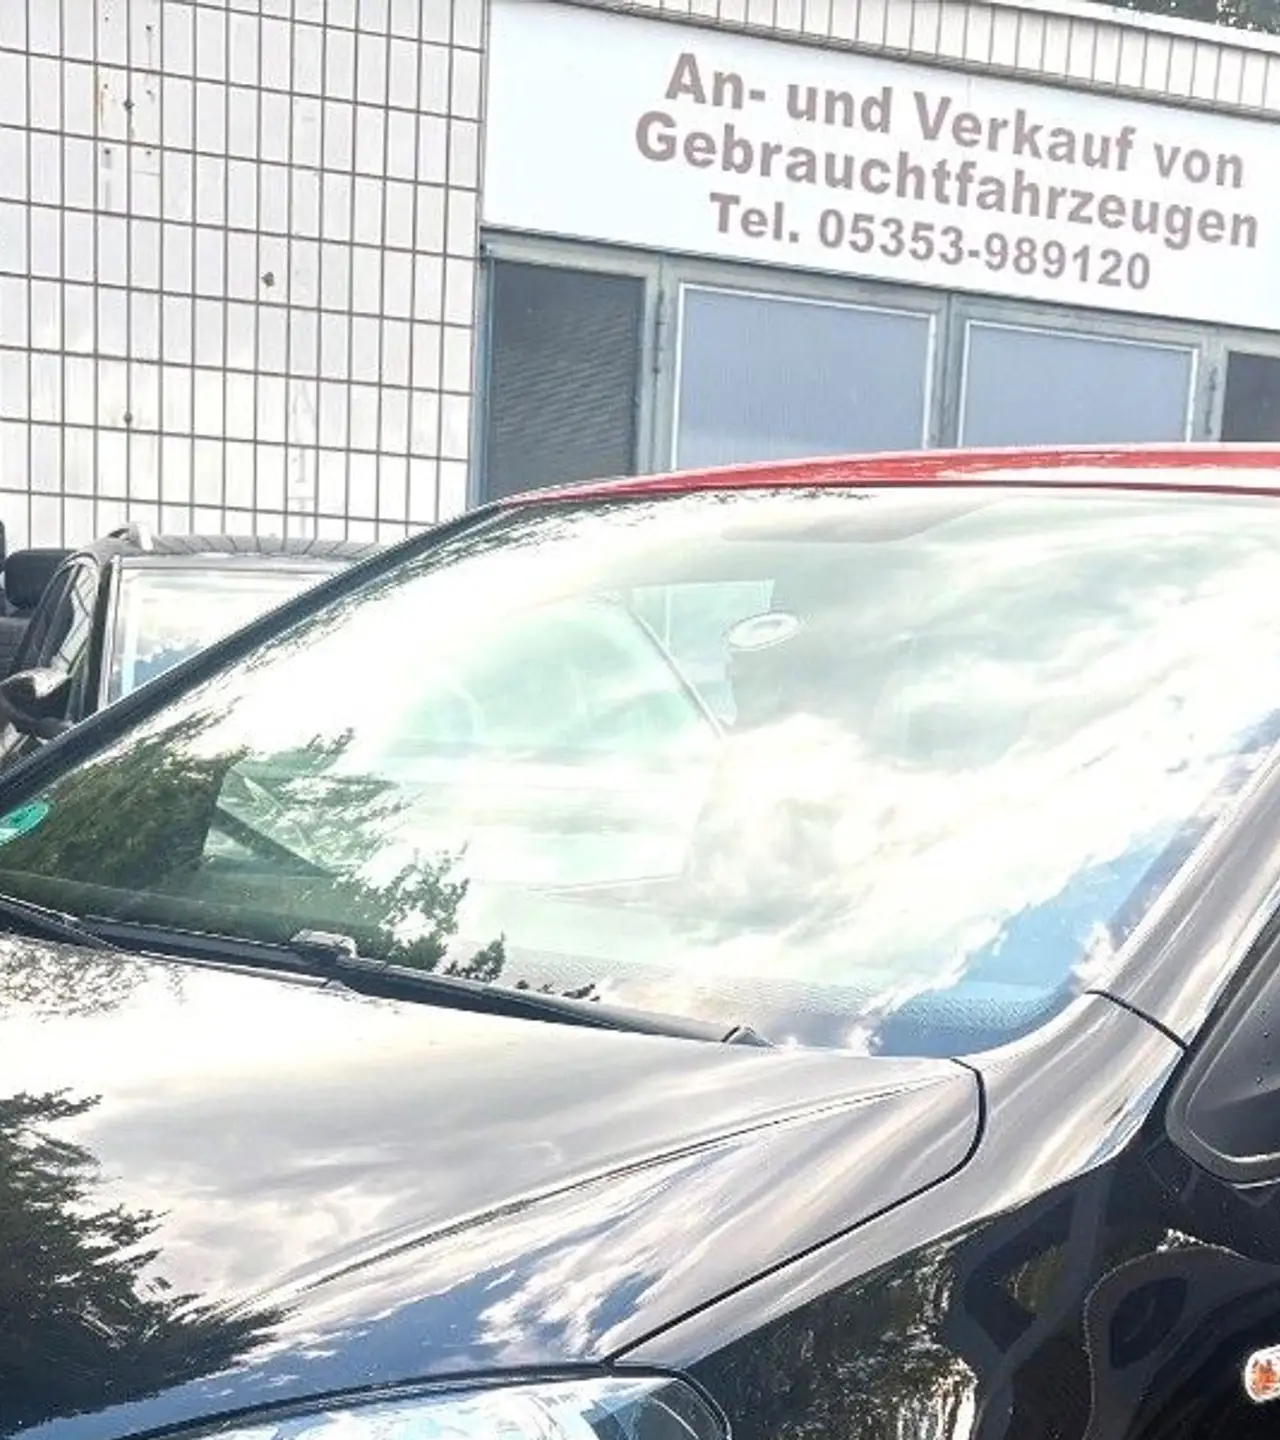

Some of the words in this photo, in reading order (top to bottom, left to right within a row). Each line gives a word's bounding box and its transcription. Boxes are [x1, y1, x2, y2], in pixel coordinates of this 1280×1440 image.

[635, 110, 1258, 251] Gebrauchtfahrzeugen
[664, 52, 766, 110] An-
[786, 83, 893, 134] und
[913, 90, 1136, 173] Verkauf
[1153, 143, 1243, 189] von
[709, 191, 800, 244] Tel.
[818, 208, 1151, 290] 05353-989120
